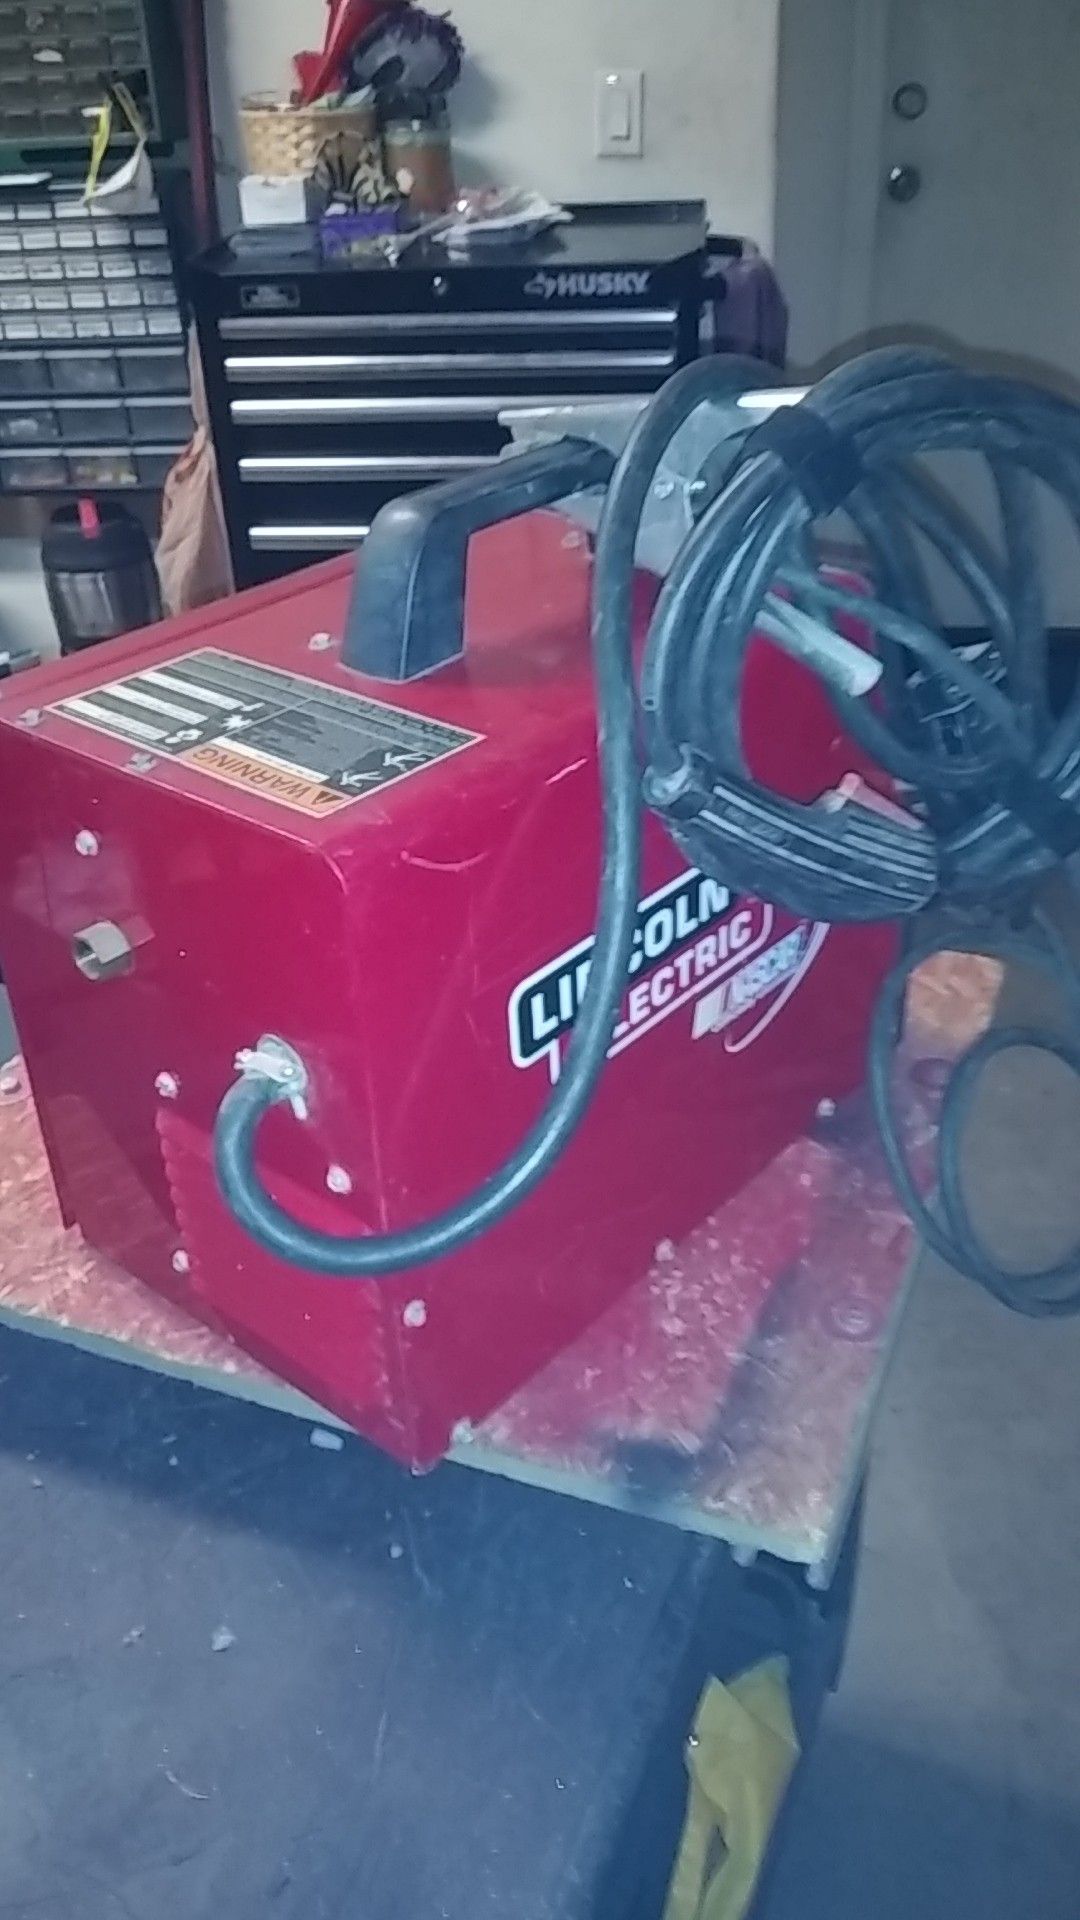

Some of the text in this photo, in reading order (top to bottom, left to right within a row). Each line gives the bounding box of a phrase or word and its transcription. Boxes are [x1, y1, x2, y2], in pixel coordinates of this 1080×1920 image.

[556, 271, 650, 297] HUSKY
[193, 747, 311, 798] WARNING
[530, 877, 729, 1041] LIOLN
[612, 910, 752, 1040] ECTRIC
